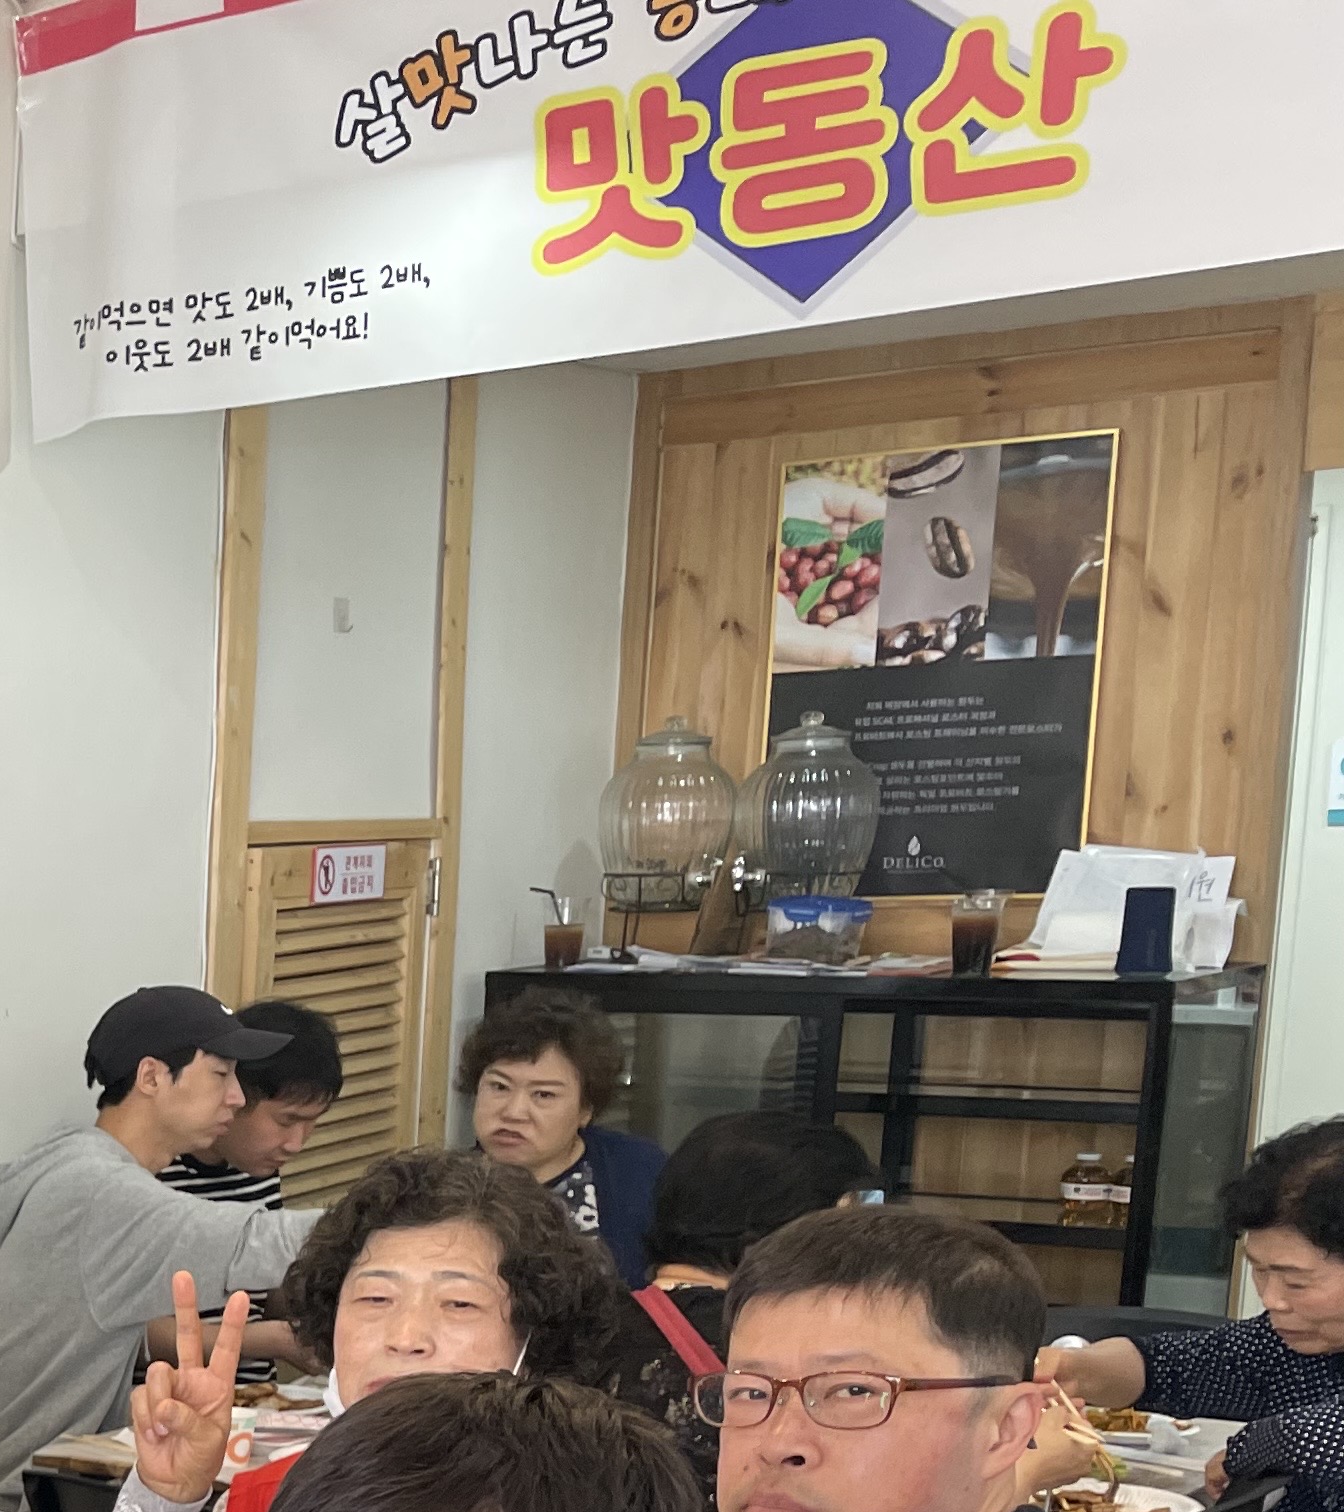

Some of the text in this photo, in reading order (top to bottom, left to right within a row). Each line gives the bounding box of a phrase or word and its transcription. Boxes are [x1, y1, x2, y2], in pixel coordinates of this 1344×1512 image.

[335, 0, 612, 162] 살맛나는
[533, 2, 1126, 276] 맛동산
[106, 312, 369, 372] 이웃도 2배 같이먹어요!
[185, 292, 234, 323] 맛도
[245, 286, 292, 311] 2배,
[304, 265, 368, 304] 기쁨도
[380, 262, 431, 289] 2배,
